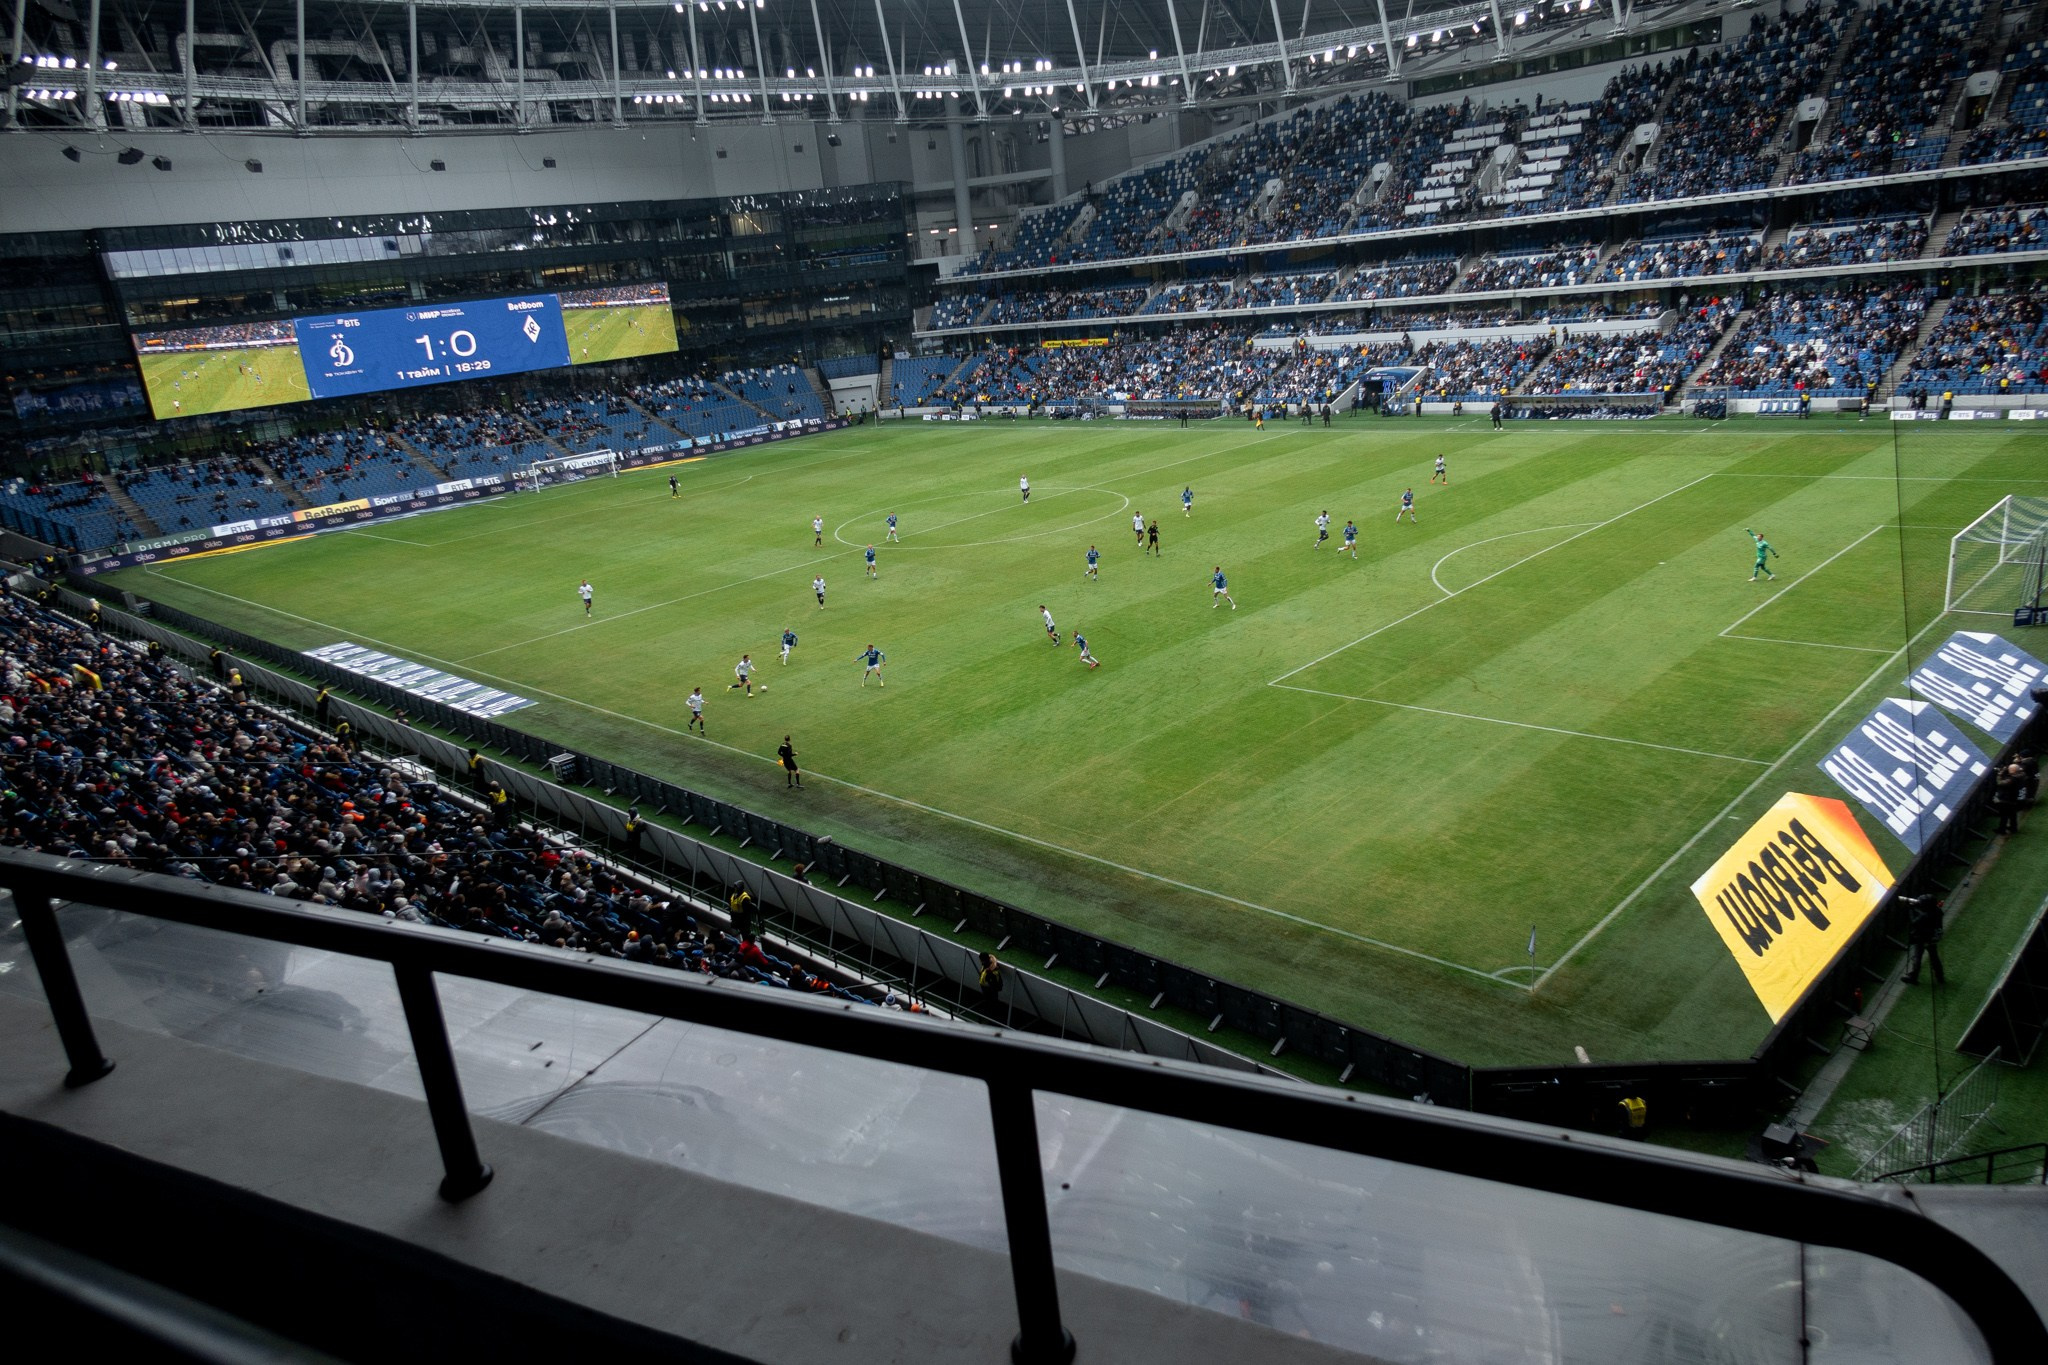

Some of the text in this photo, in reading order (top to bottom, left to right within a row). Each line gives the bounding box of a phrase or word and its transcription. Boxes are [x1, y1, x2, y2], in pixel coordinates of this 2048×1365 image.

[507, 301, 544, 311] BetBoom
[344, 319, 361, 328] ВТБ
[419, 311, 441, 320] МИР
[415, 330, 477, 360] 1:0
[397, 360, 491, 380] 1 тайм 18:29
[483, 476, 501, 486] ВТБ
[138, 533, 207, 551] DIGMA PRO
[1825, 711, 1961, 835] ВТБ ВТБ
[1715, 817, 1862, 957] BetBoom
